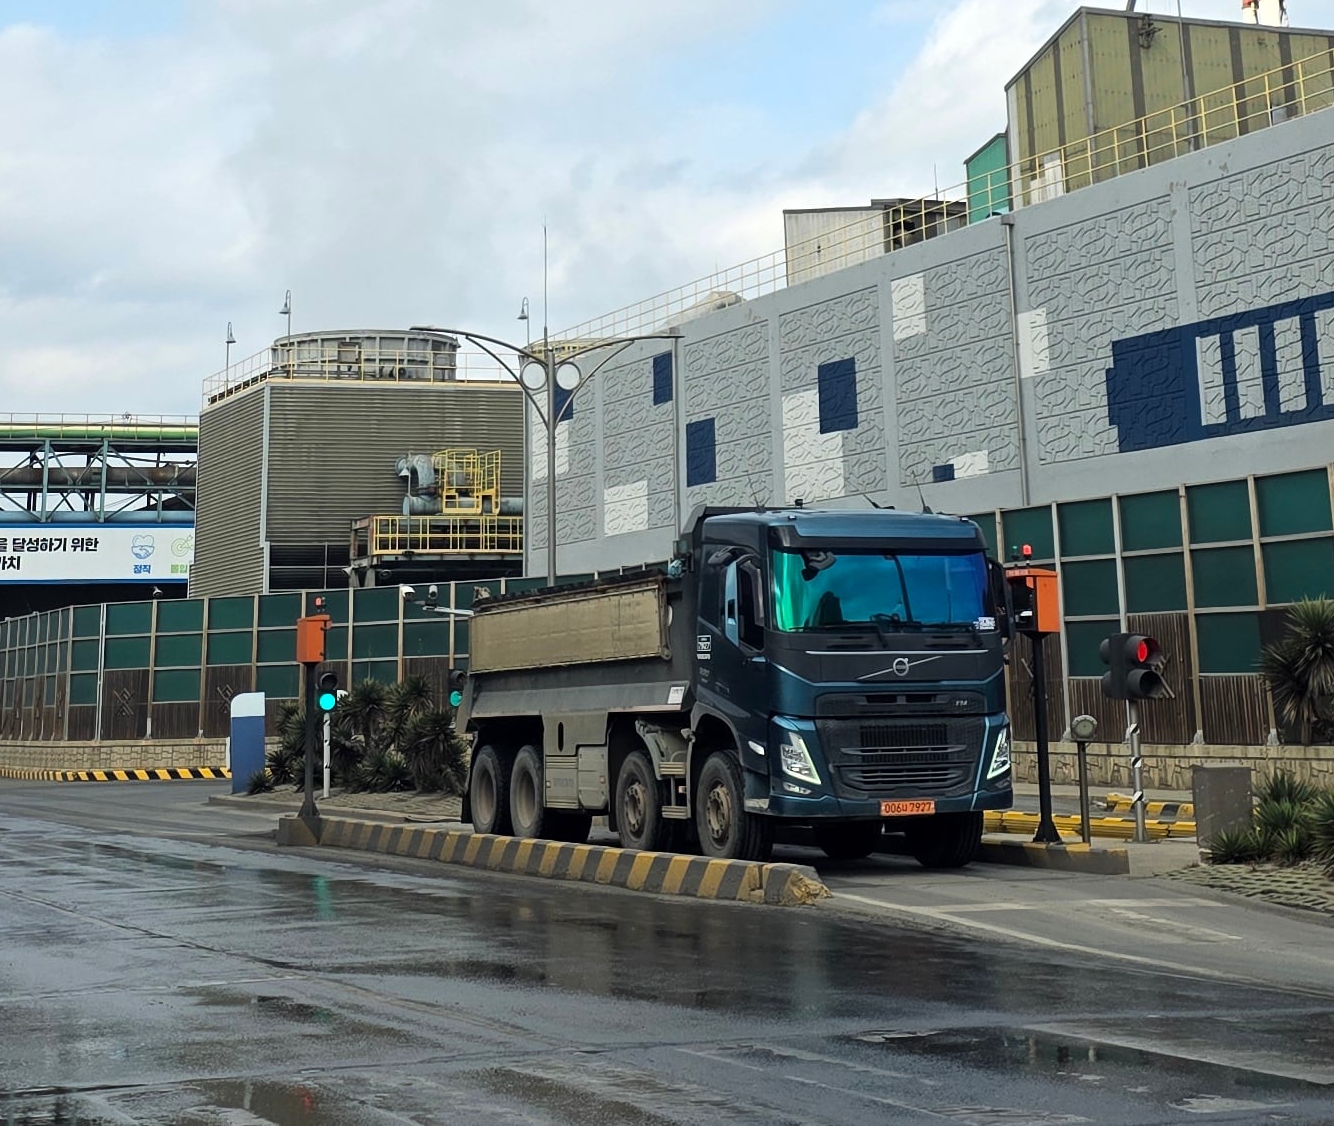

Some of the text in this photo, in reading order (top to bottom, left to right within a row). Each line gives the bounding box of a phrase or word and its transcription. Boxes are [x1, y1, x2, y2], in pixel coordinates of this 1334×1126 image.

[12, 537, 67, 553] 달성하기
[71, 537, 99, 553] 위한
[133, 564, 151, 574] 정직
